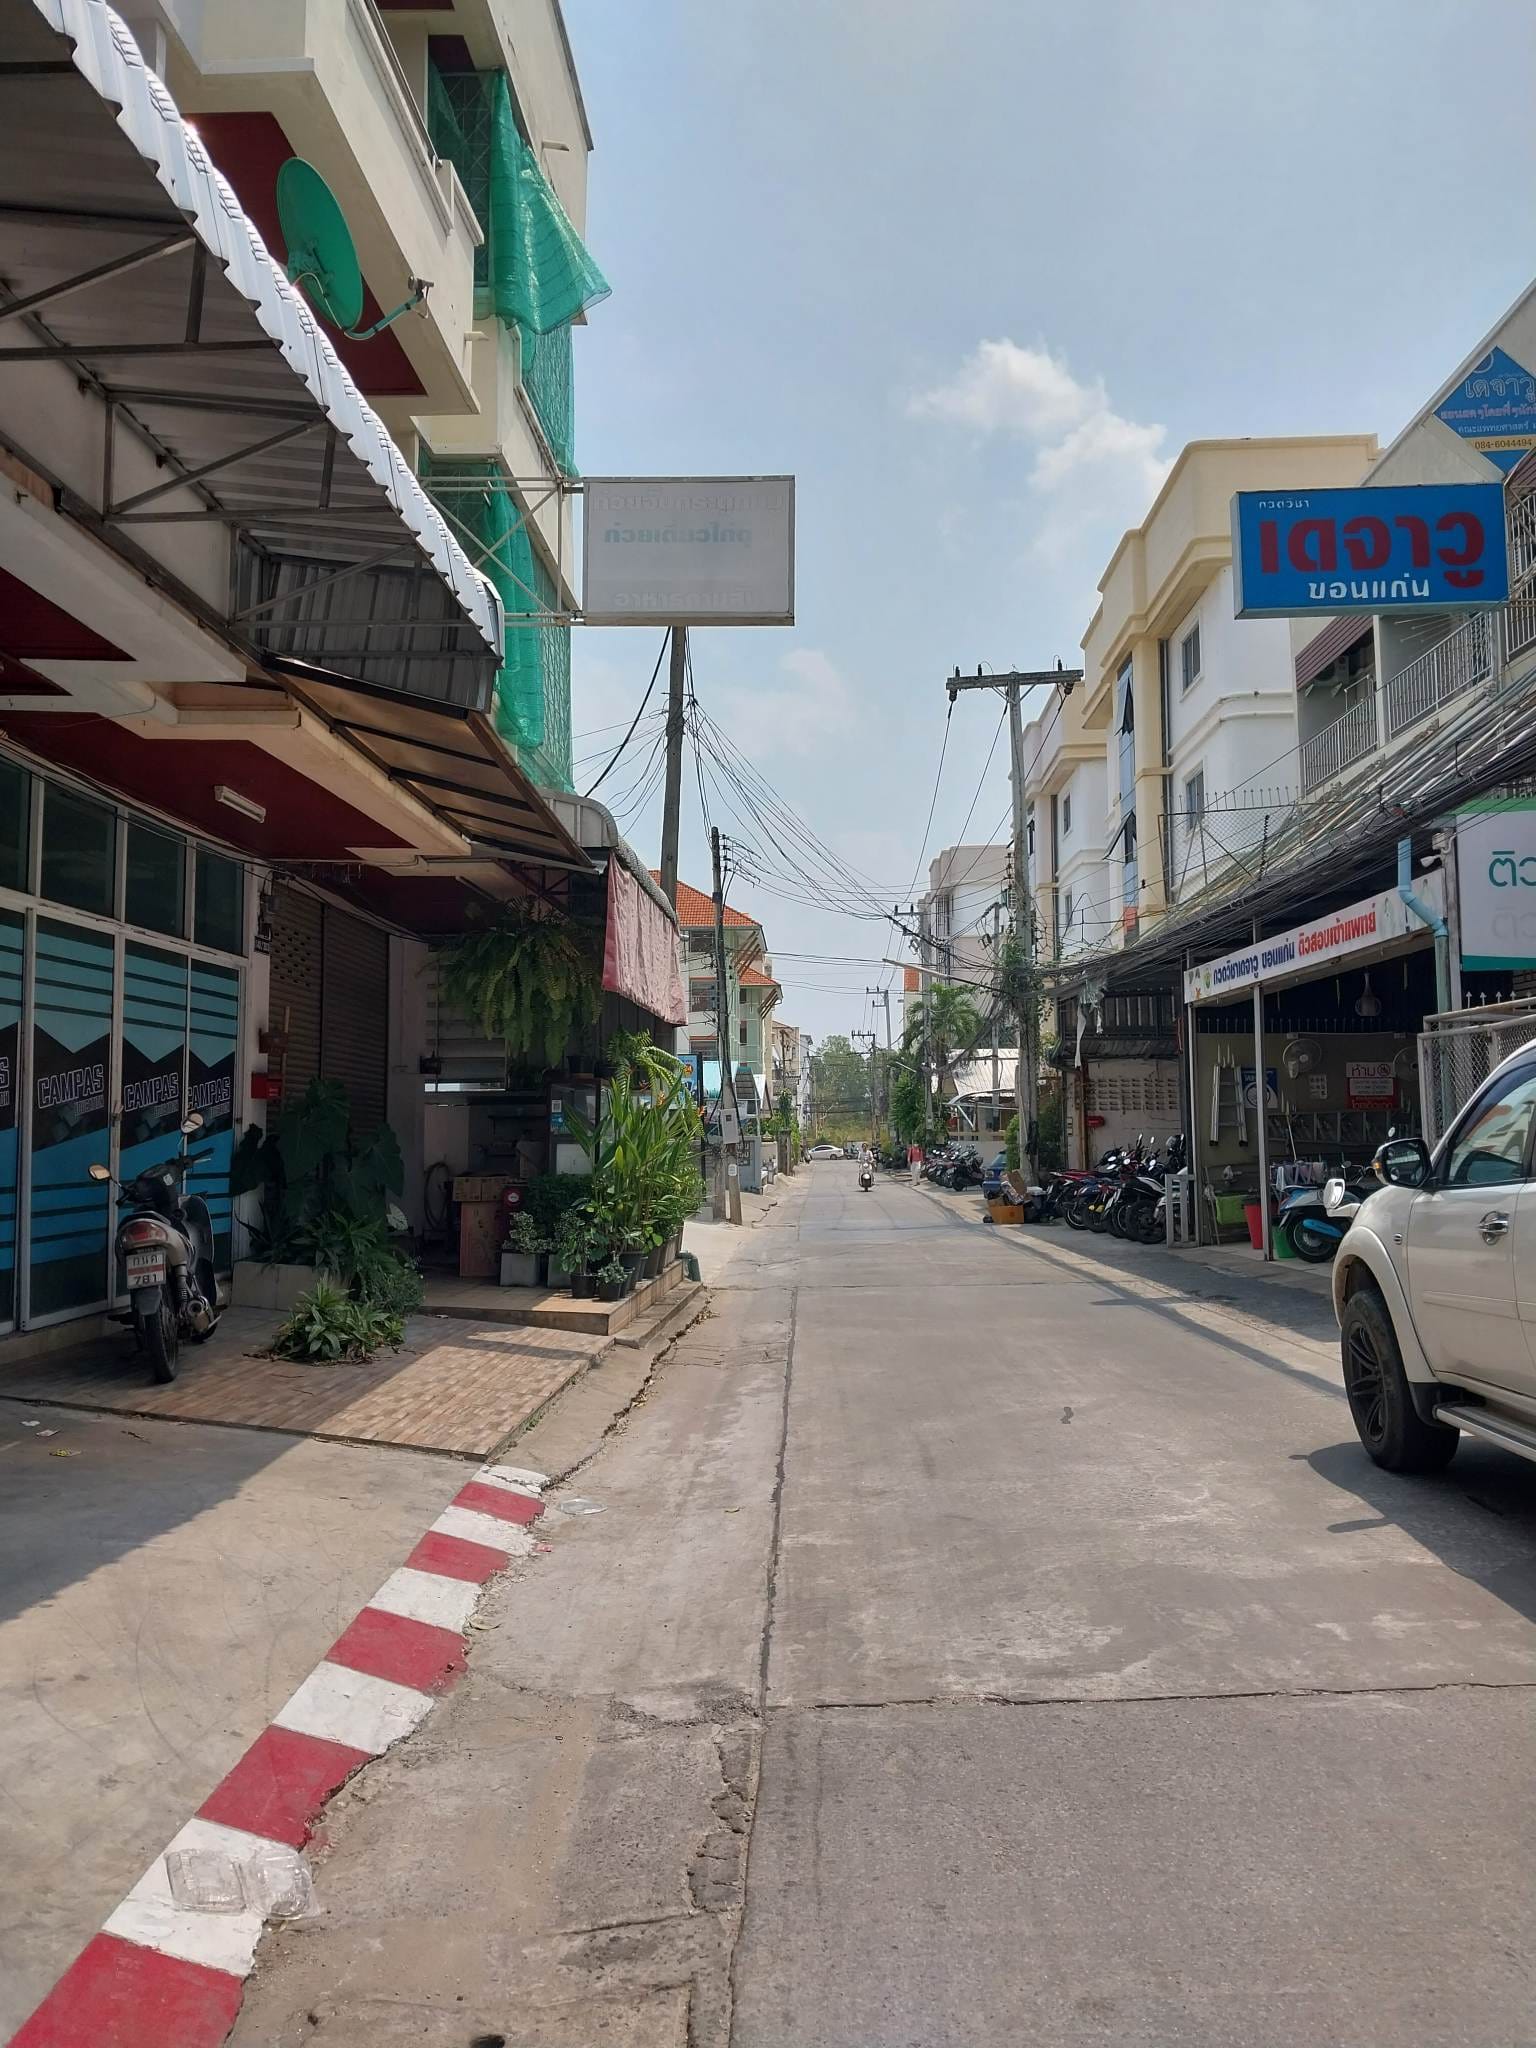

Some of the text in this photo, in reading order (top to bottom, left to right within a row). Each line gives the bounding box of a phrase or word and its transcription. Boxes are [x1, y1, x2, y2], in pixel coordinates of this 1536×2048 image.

[1258, 499, 1310, 510] กวดวิชา
[1257, 511, 1486, 589] เดจาวู
[1308, 573, 1430, 600] ขอนแก่น
[1213, 902, 1377, 985] กวดวิชาเดจาวู ขอนแก่น ติวสอบเข้าแพทย์
[37, 1063, 104, 1109] CAMPAS
[124, 1072, 179, 1112] CAMPAS
